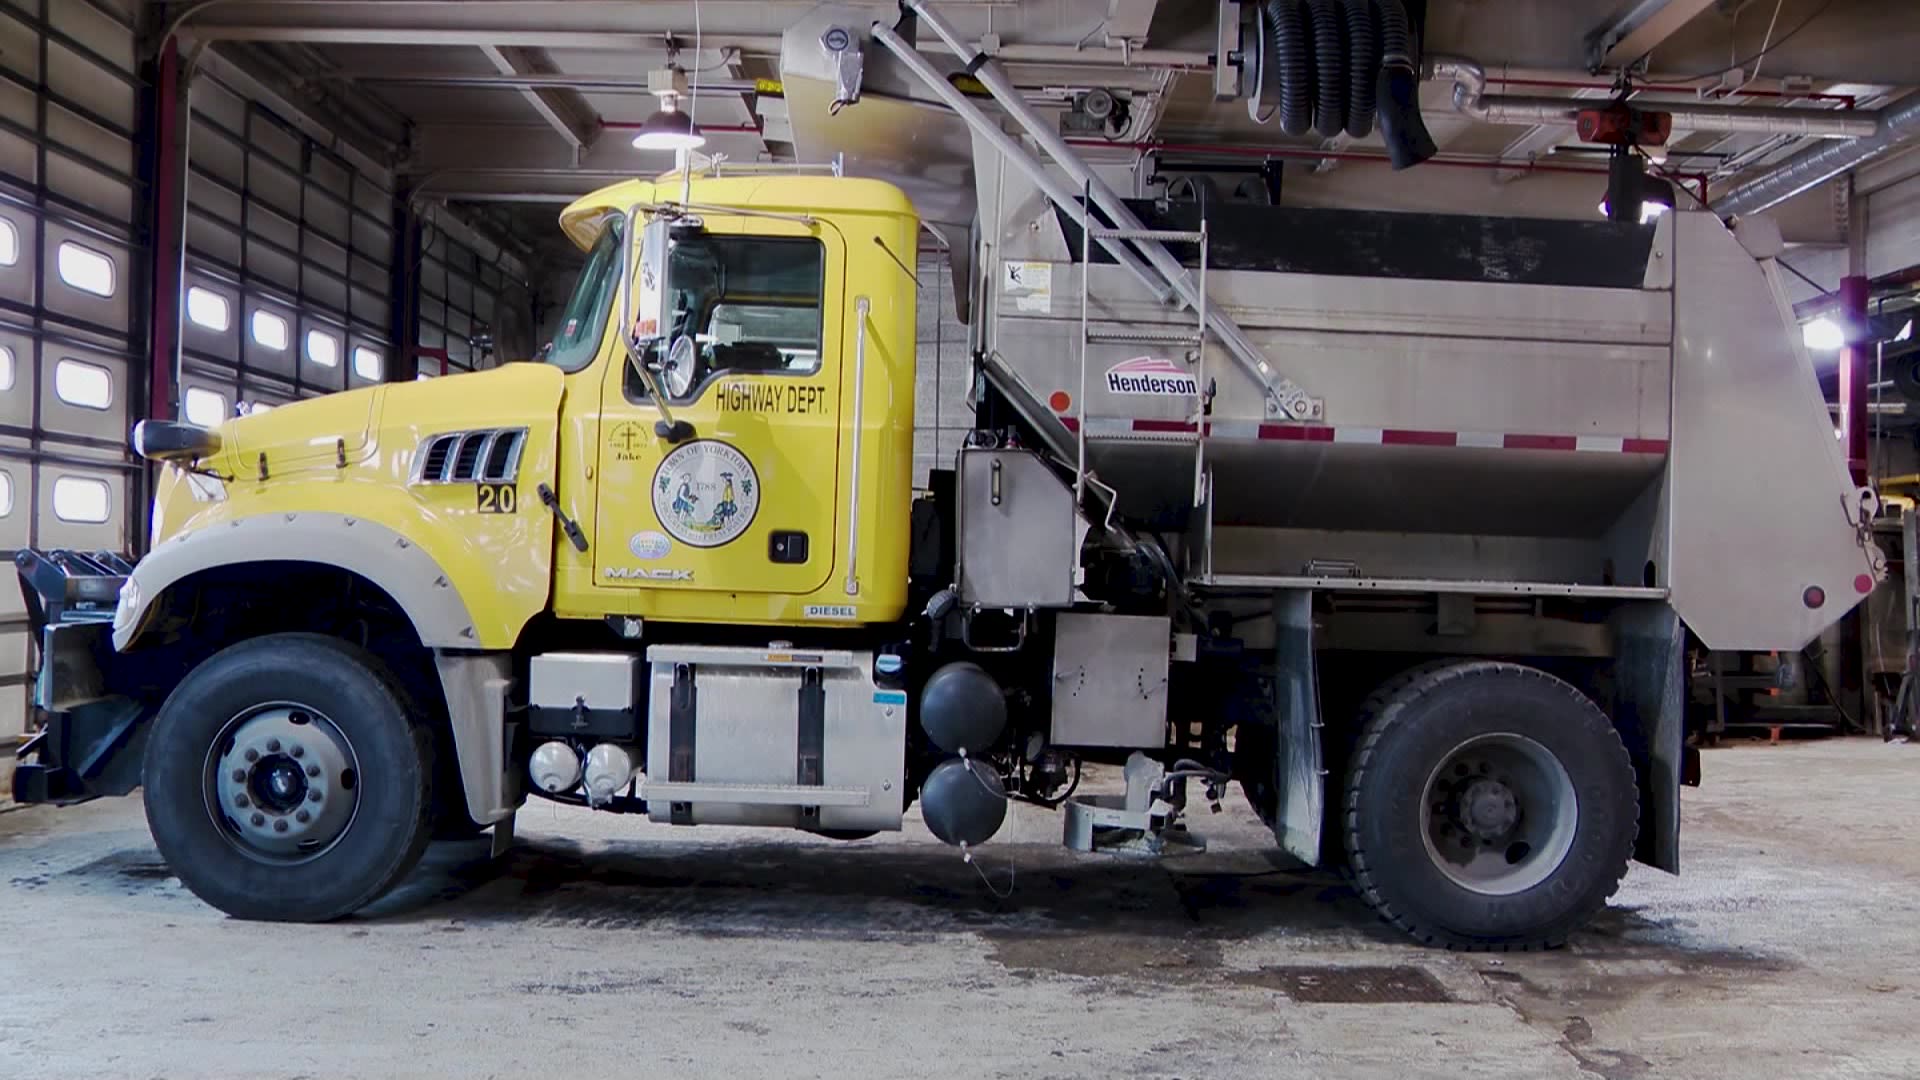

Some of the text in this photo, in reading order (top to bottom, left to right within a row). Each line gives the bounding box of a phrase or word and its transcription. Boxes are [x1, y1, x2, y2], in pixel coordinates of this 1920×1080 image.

[1108, 372, 1197, 394] Henderson
[715, 383, 828, 414] HIGHWAY DEPT.
[663, 453, 685, 475] TOWN
[703, 444, 752, 478] YORKTOWN
[479, 484, 514, 513] 20
[604, 567, 695, 582] MACK
[810, 606, 856, 616] DIESEL
